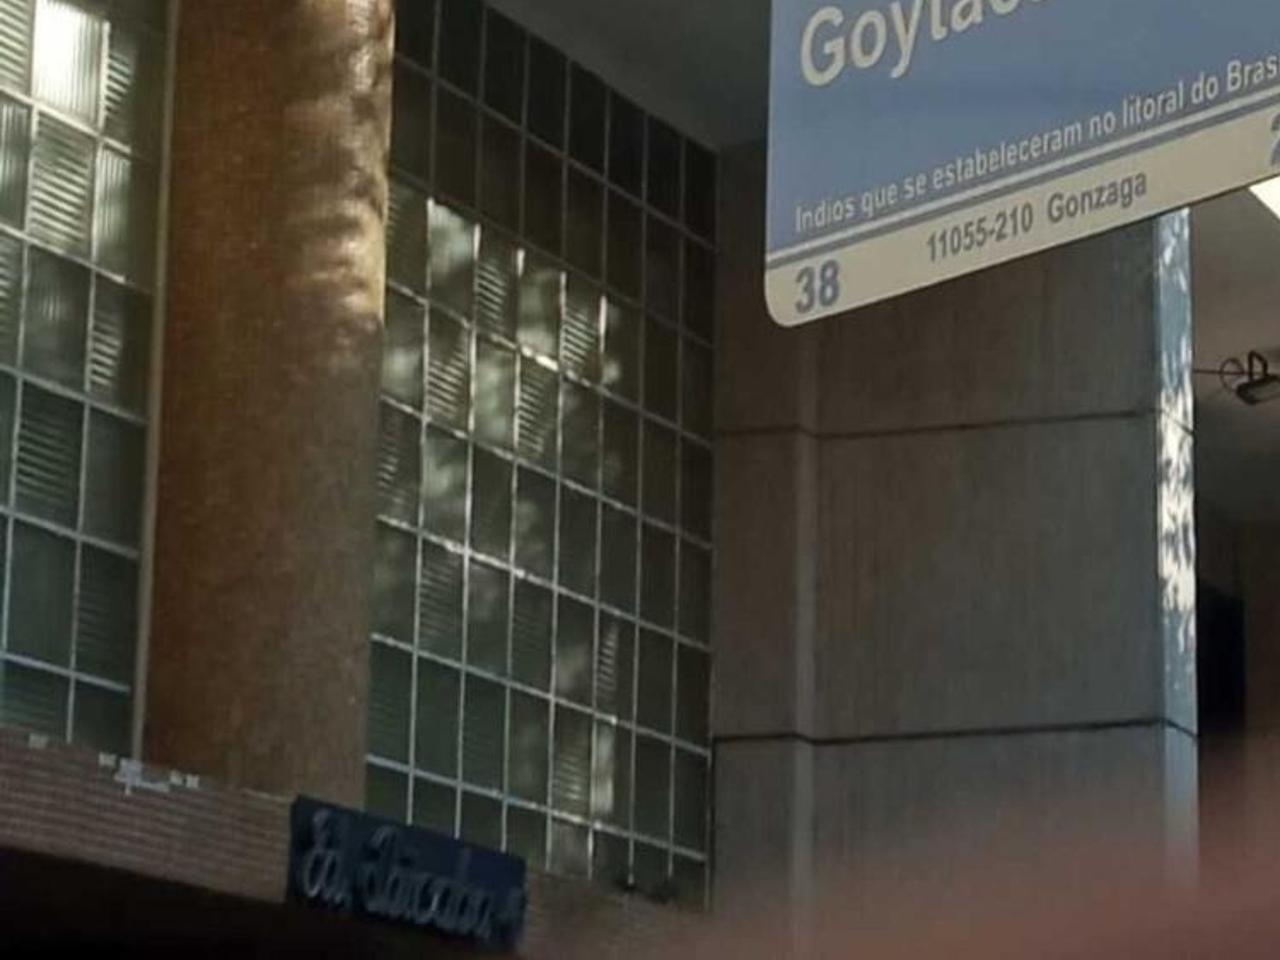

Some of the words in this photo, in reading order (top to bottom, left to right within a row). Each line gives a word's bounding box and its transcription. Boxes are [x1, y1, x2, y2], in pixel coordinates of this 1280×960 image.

[861, 183, 899, 218] que
[904, 173, 927, 199] se
[932, 121, 1082, 189] estabeleceram
[1089, 109, 1116, 139] no
[1122, 80, 1184, 126] litoral
[1191, 72, 1219, 104] do
[927, 203, 1034, 262] 11055-210
[1047, 172, 1147, 223] Gonzaga
[795, 259, 841, 315] 38
